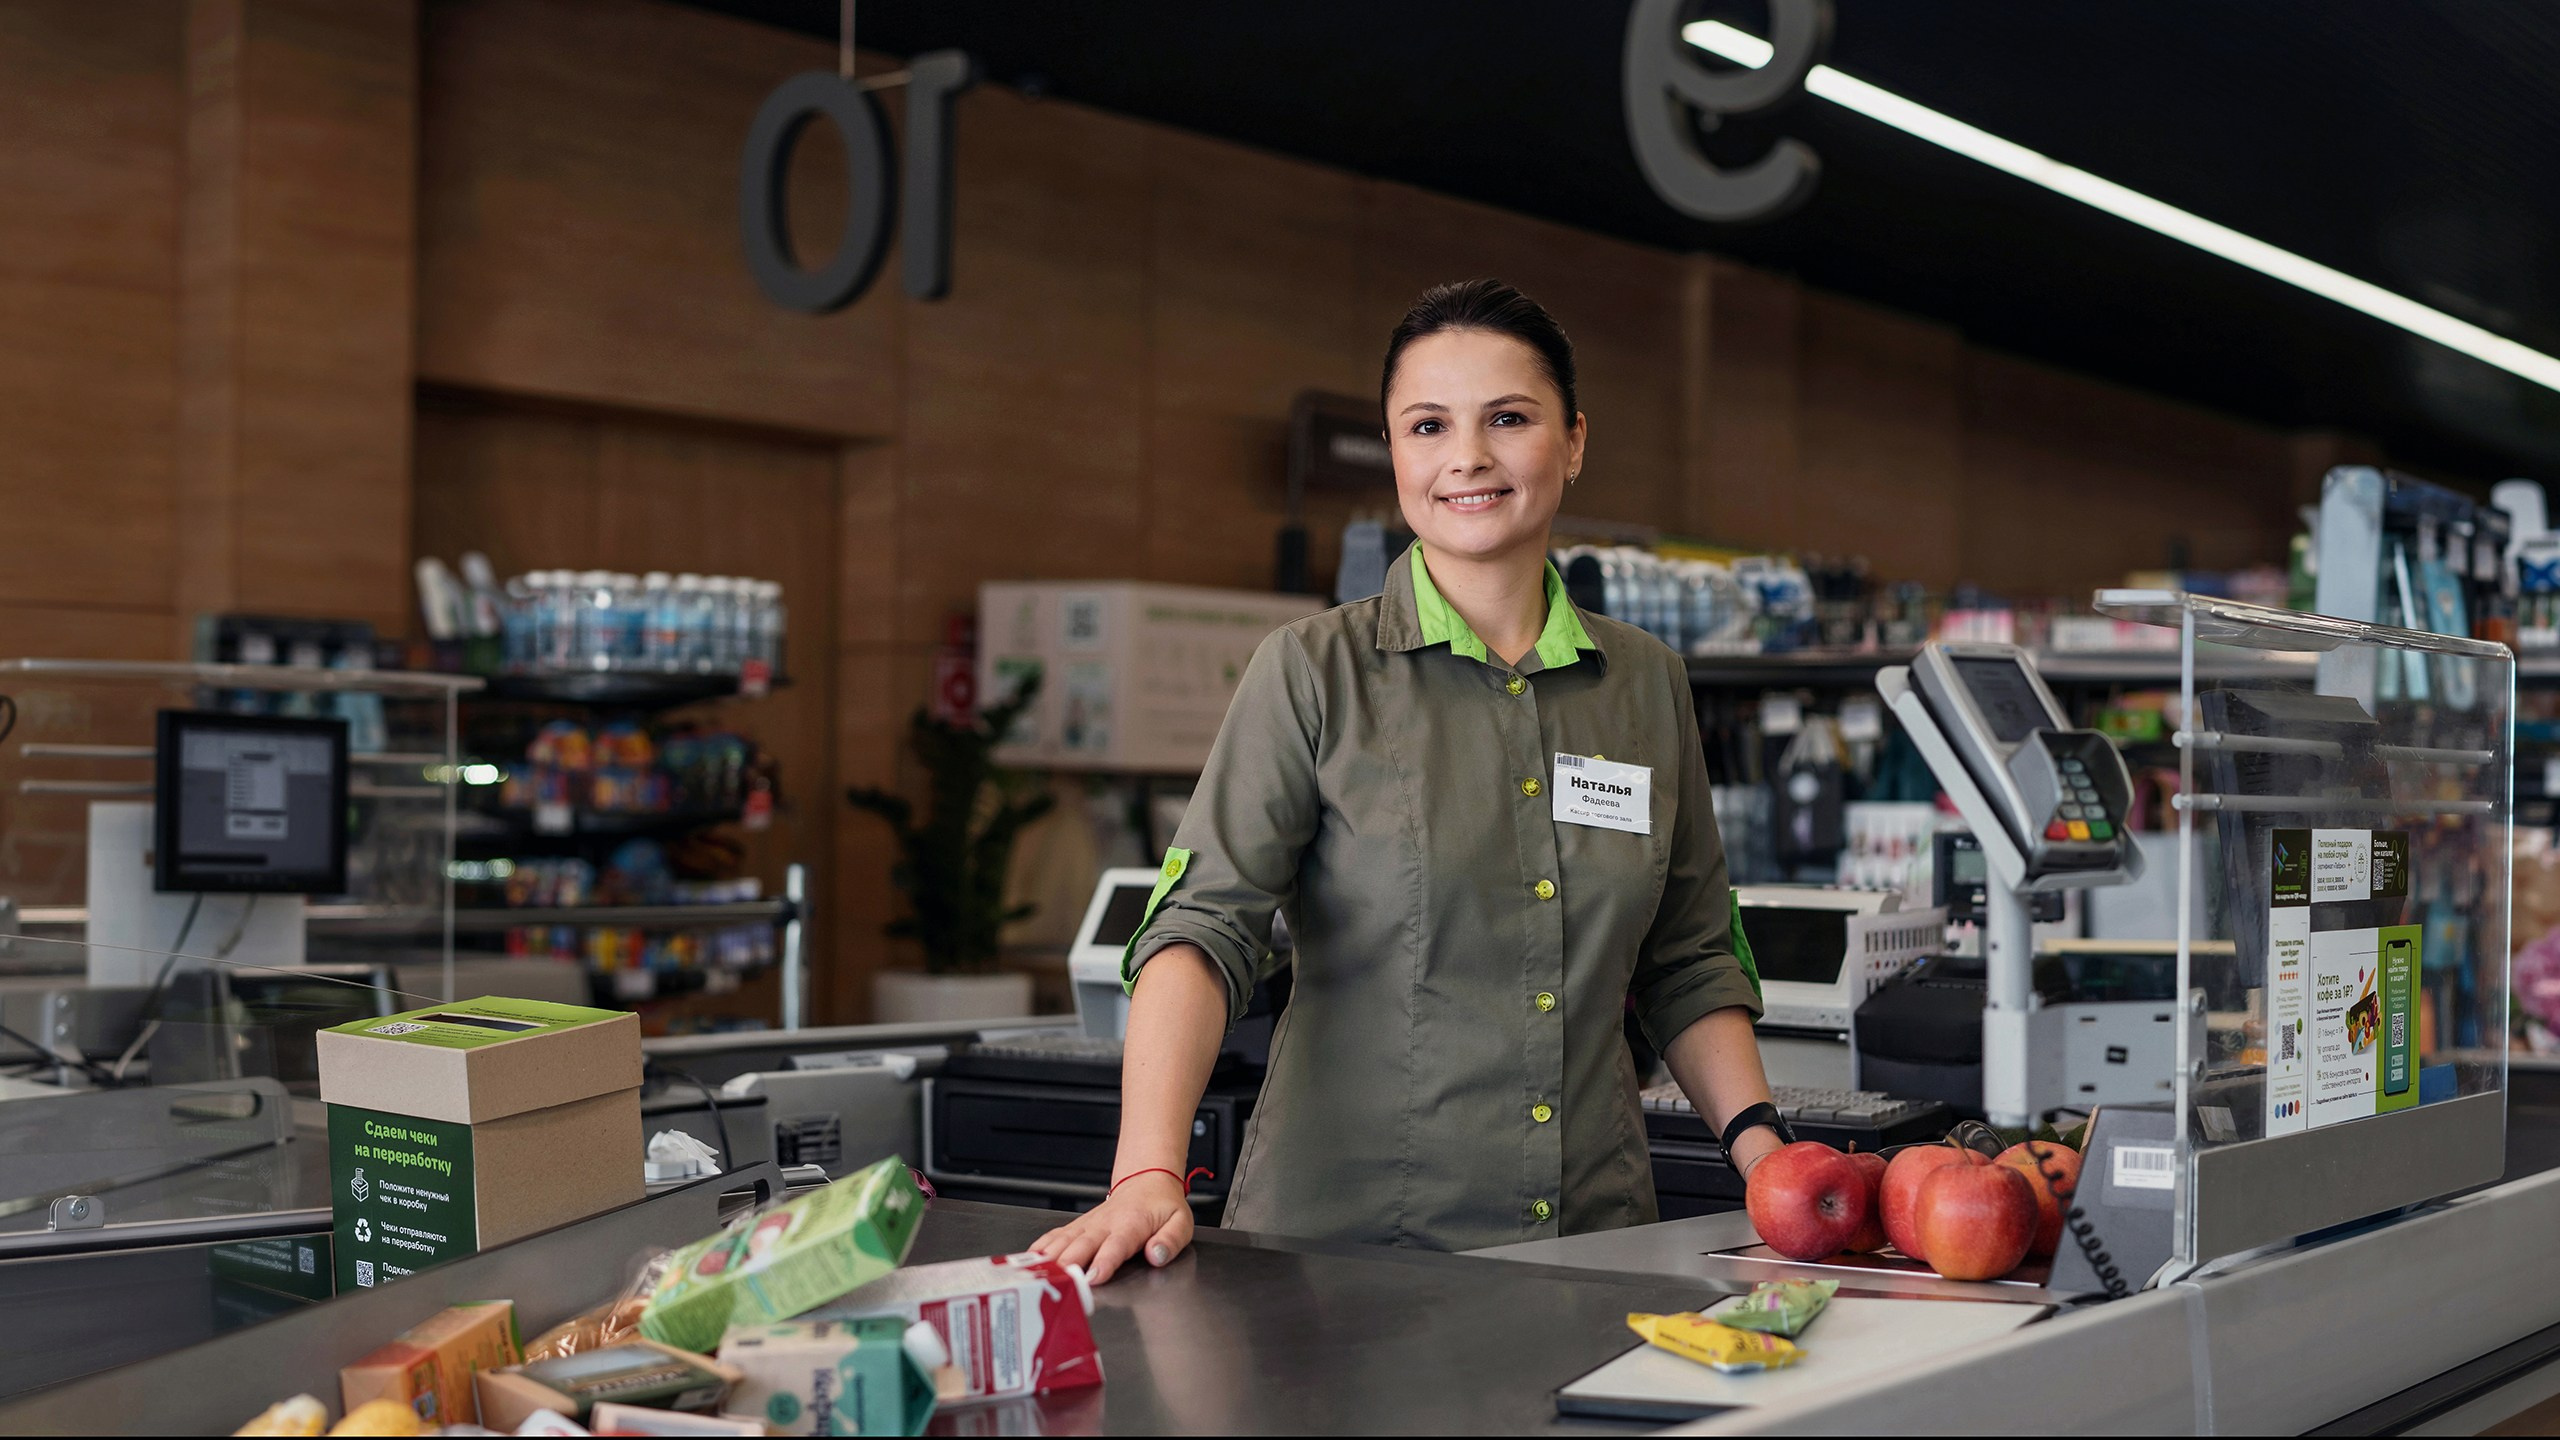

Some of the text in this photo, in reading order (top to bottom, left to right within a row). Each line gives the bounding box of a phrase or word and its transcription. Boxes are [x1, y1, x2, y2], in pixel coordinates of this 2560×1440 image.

[1571, 776, 1632, 796] Наталья
[1582, 795, 1620, 808] Фадеева
[2317, 973, 2339, 986] Хотите
[2317, 987, 2333, 1003] кофе
[2334, 989, 2341, 999] за
[364, 1120, 438, 1146] Сдаем чеки
[354, 1144, 452, 1176] на переработку
[380, 1180, 450, 1203] Положите ненужный
[380, 1195, 391, 1203] чек
[399, 1198, 428, 1213] коробку
[381, 1221, 447, 1243] Чеки отправляются
[382, 1236, 435, 1256] на переработку
